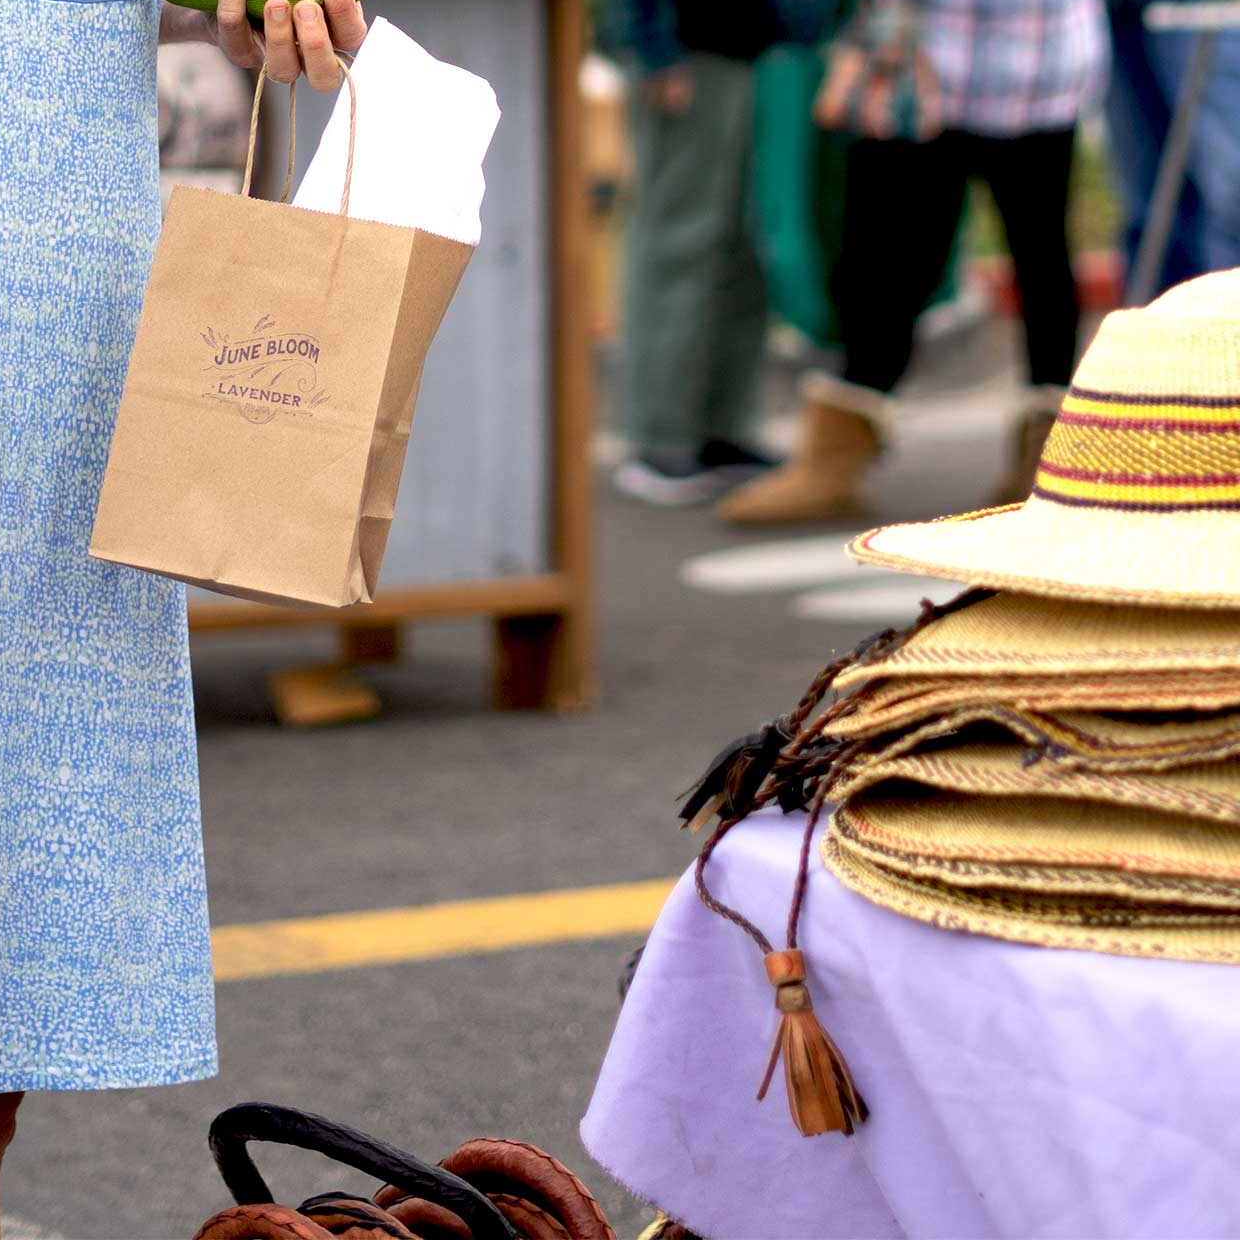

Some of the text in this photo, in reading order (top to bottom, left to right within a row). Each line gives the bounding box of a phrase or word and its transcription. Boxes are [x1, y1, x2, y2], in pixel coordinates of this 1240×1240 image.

[214, 339, 320, 365] JUNE BLOOM
[218, 383, 301, 407] LAVENDER
